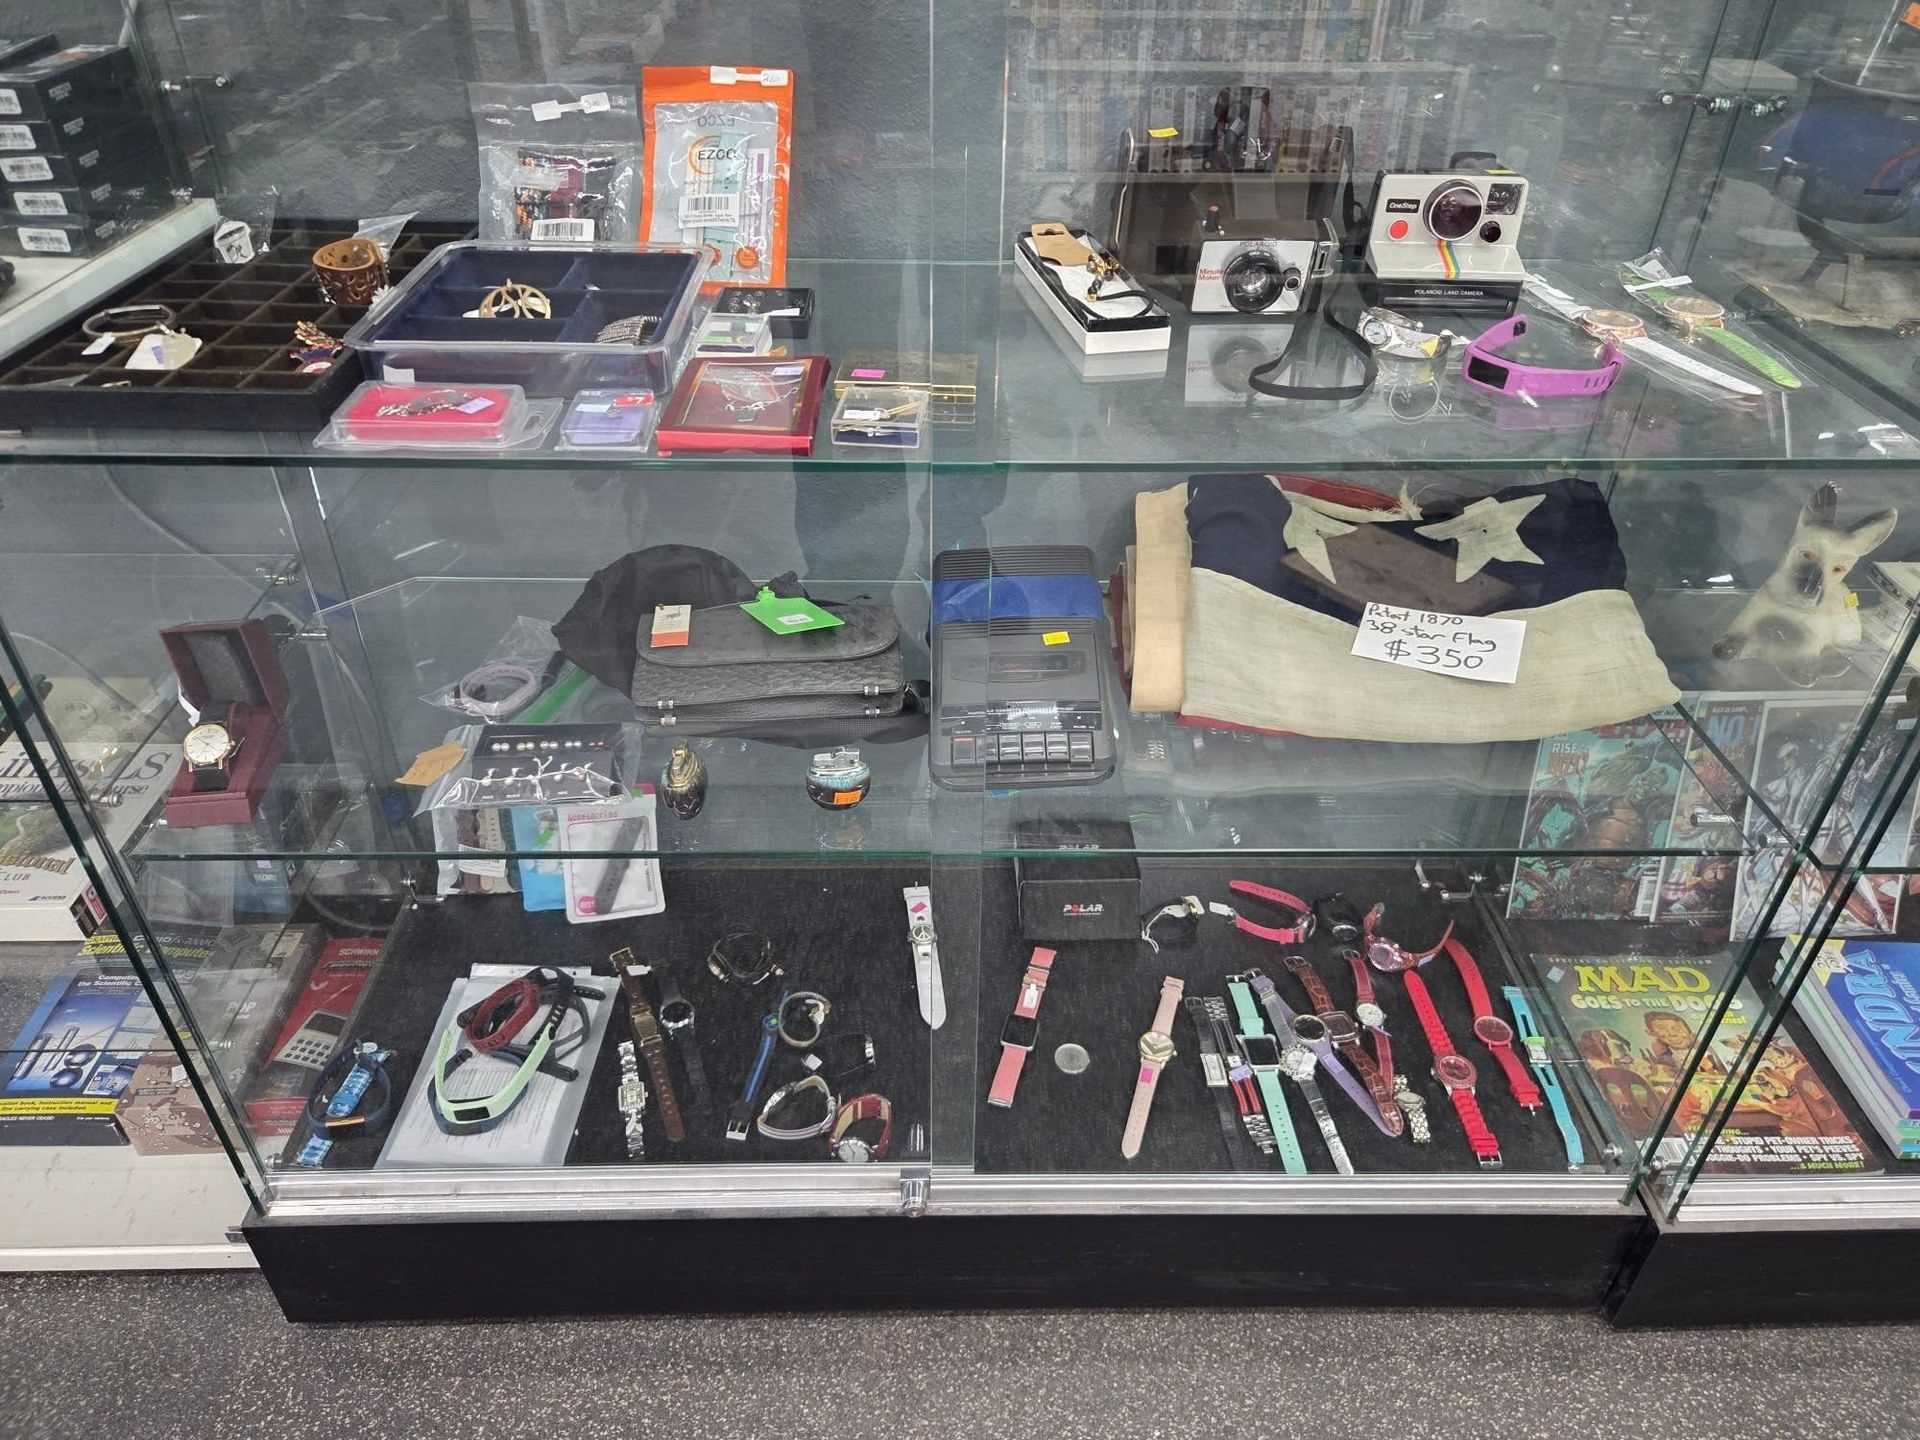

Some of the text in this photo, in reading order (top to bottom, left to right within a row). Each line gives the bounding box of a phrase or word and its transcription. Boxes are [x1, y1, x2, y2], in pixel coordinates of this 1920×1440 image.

[1420, 613, 1463, 625] 1870
[1366, 619, 1397, 634] 38
[1452, 632, 1497, 652] Flag
[1552, 743, 1578, 753] RISE
[1063, 904, 1103, 912] POLAR
[1574, 965, 1711, 992] MAD
[1571, 994, 1622, 1009] GOES
[1730, 1136, 1764, 1145] STUPID
[1763, 1136, 1819, 1145] PET-OWNER
[1817, 1136, 1854, 1144] TRICKS
[1715, 1145, 1763, 1154] THOUGHTS
[1769, 1145, 1796, 1154] YOUR
[1795, 1145, 1824, 1154] PET'S
[1822, 1145, 1860, 1153] PEEVES
[1751, 1154, 1802, 1162] PROBLEMS
[1809, 1154, 1829, 1162] SPY
[1844, 1153, 1864, 1161] SPY
